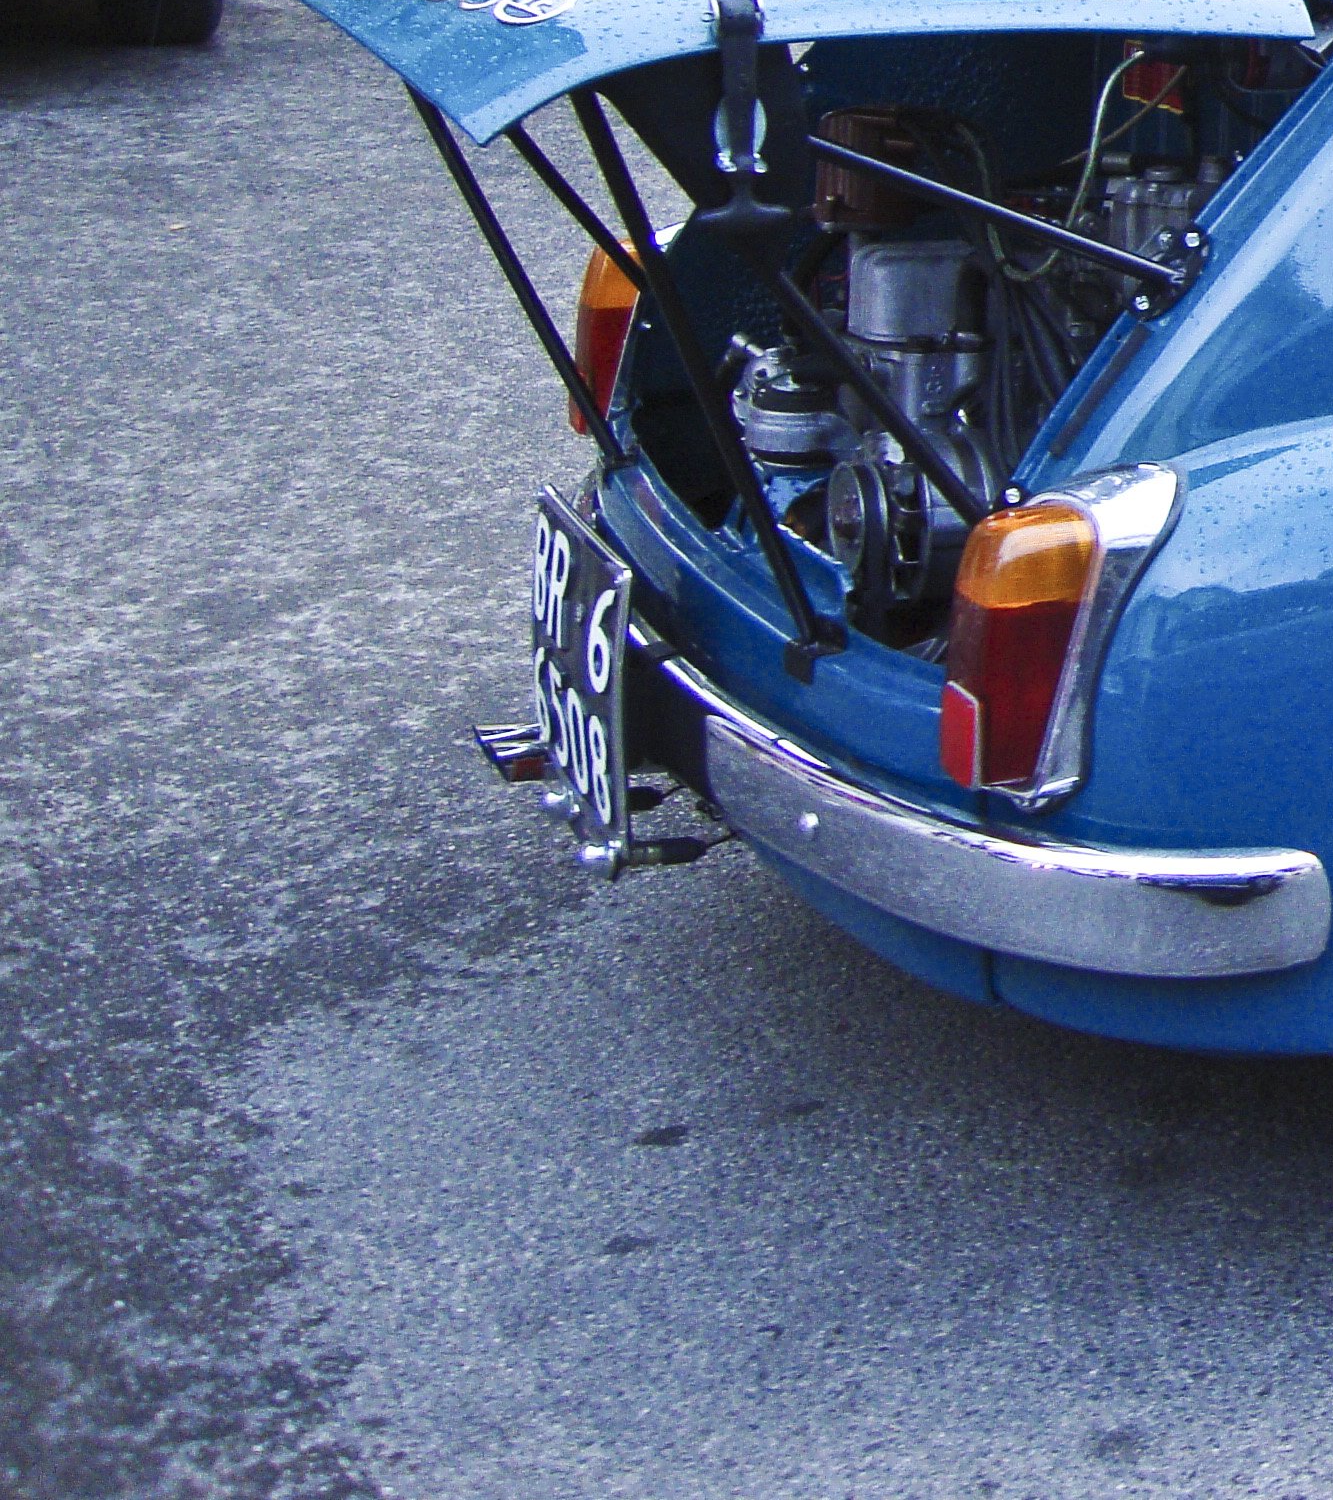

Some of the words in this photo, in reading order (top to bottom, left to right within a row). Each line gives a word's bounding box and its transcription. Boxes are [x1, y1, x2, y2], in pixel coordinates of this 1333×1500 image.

[534, 511, 570, 649] BR
[587, 588, 616, 694] 6
[534, 646, 611, 826] 6508
